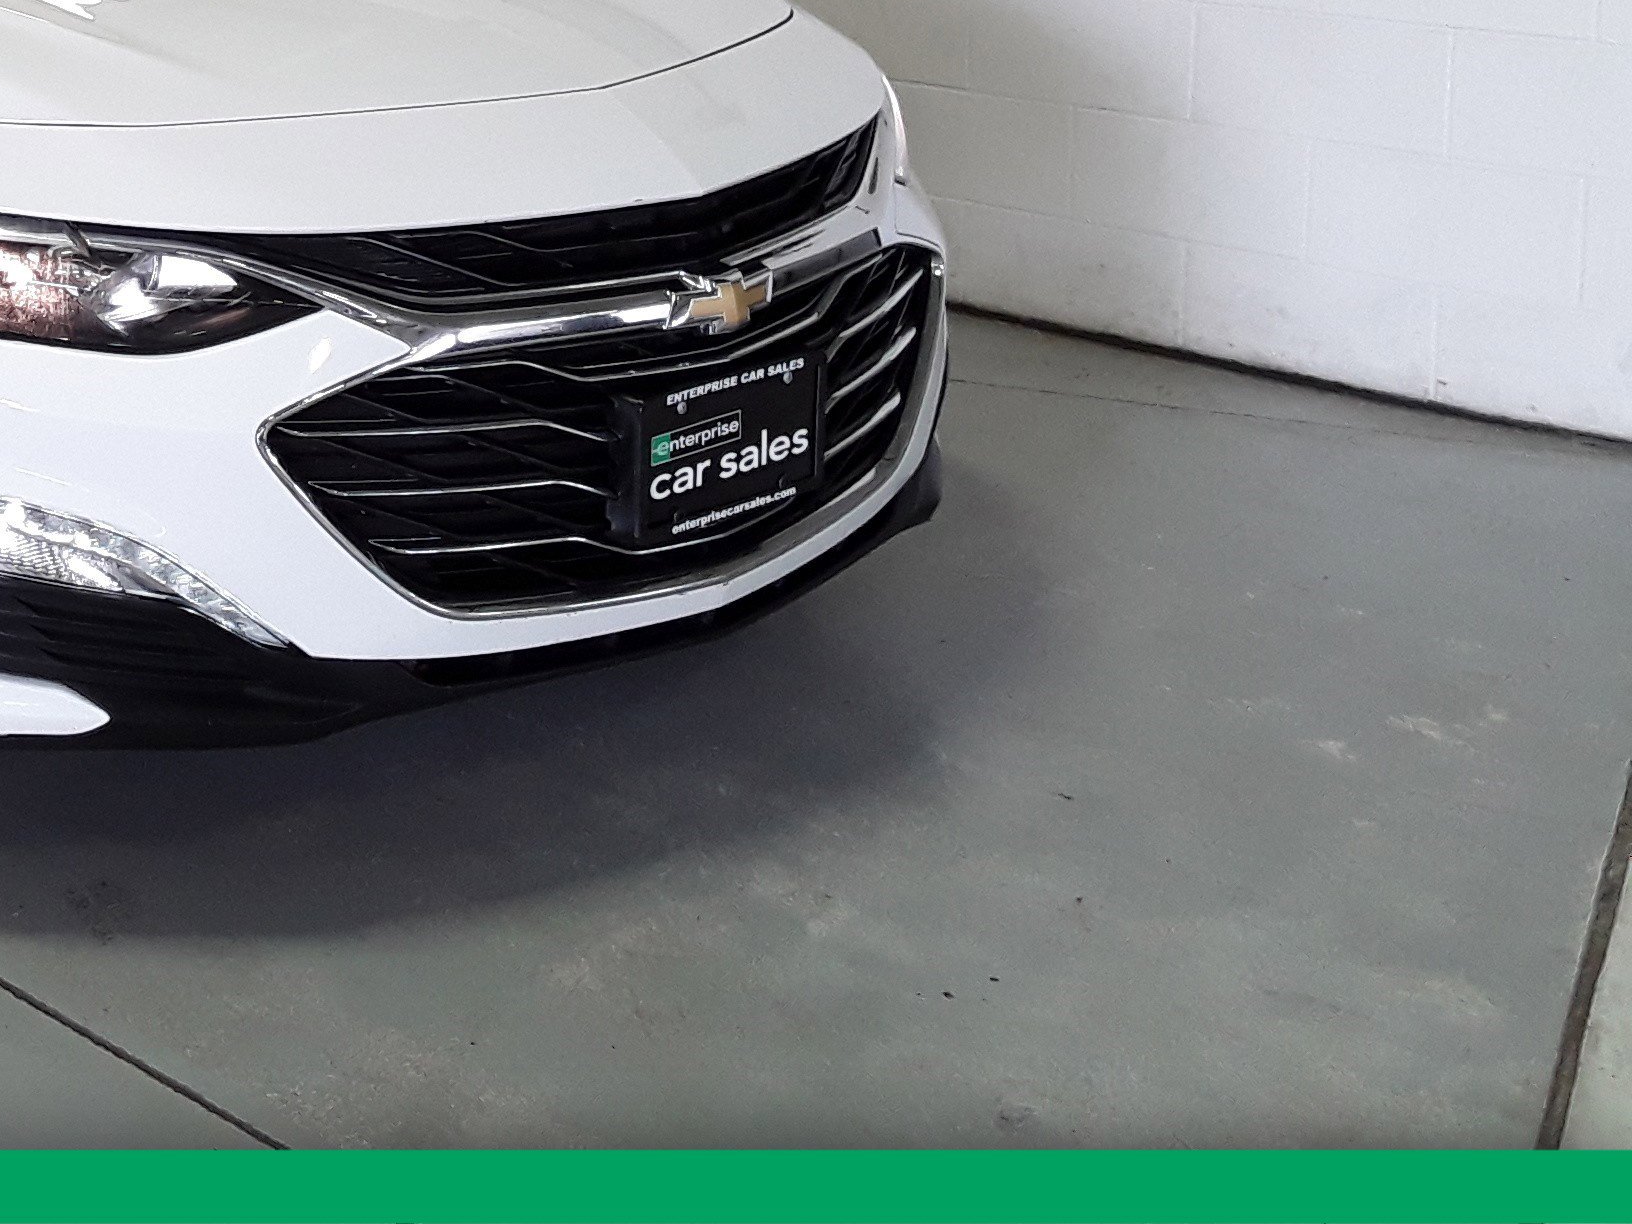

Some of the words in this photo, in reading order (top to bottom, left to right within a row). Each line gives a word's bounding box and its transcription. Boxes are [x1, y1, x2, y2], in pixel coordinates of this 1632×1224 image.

[667, 376, 738, 406] ENTERPRISE
[740, 368, 765, 384] CAR
[767, 358, 805, 376] SALES
[652, 419, 741, 457] enterprise
[649, 459, 712, 500] car
[718, 428, 809, 479] sales
[672, 487, 796, 534] enterprisecarsales.com
